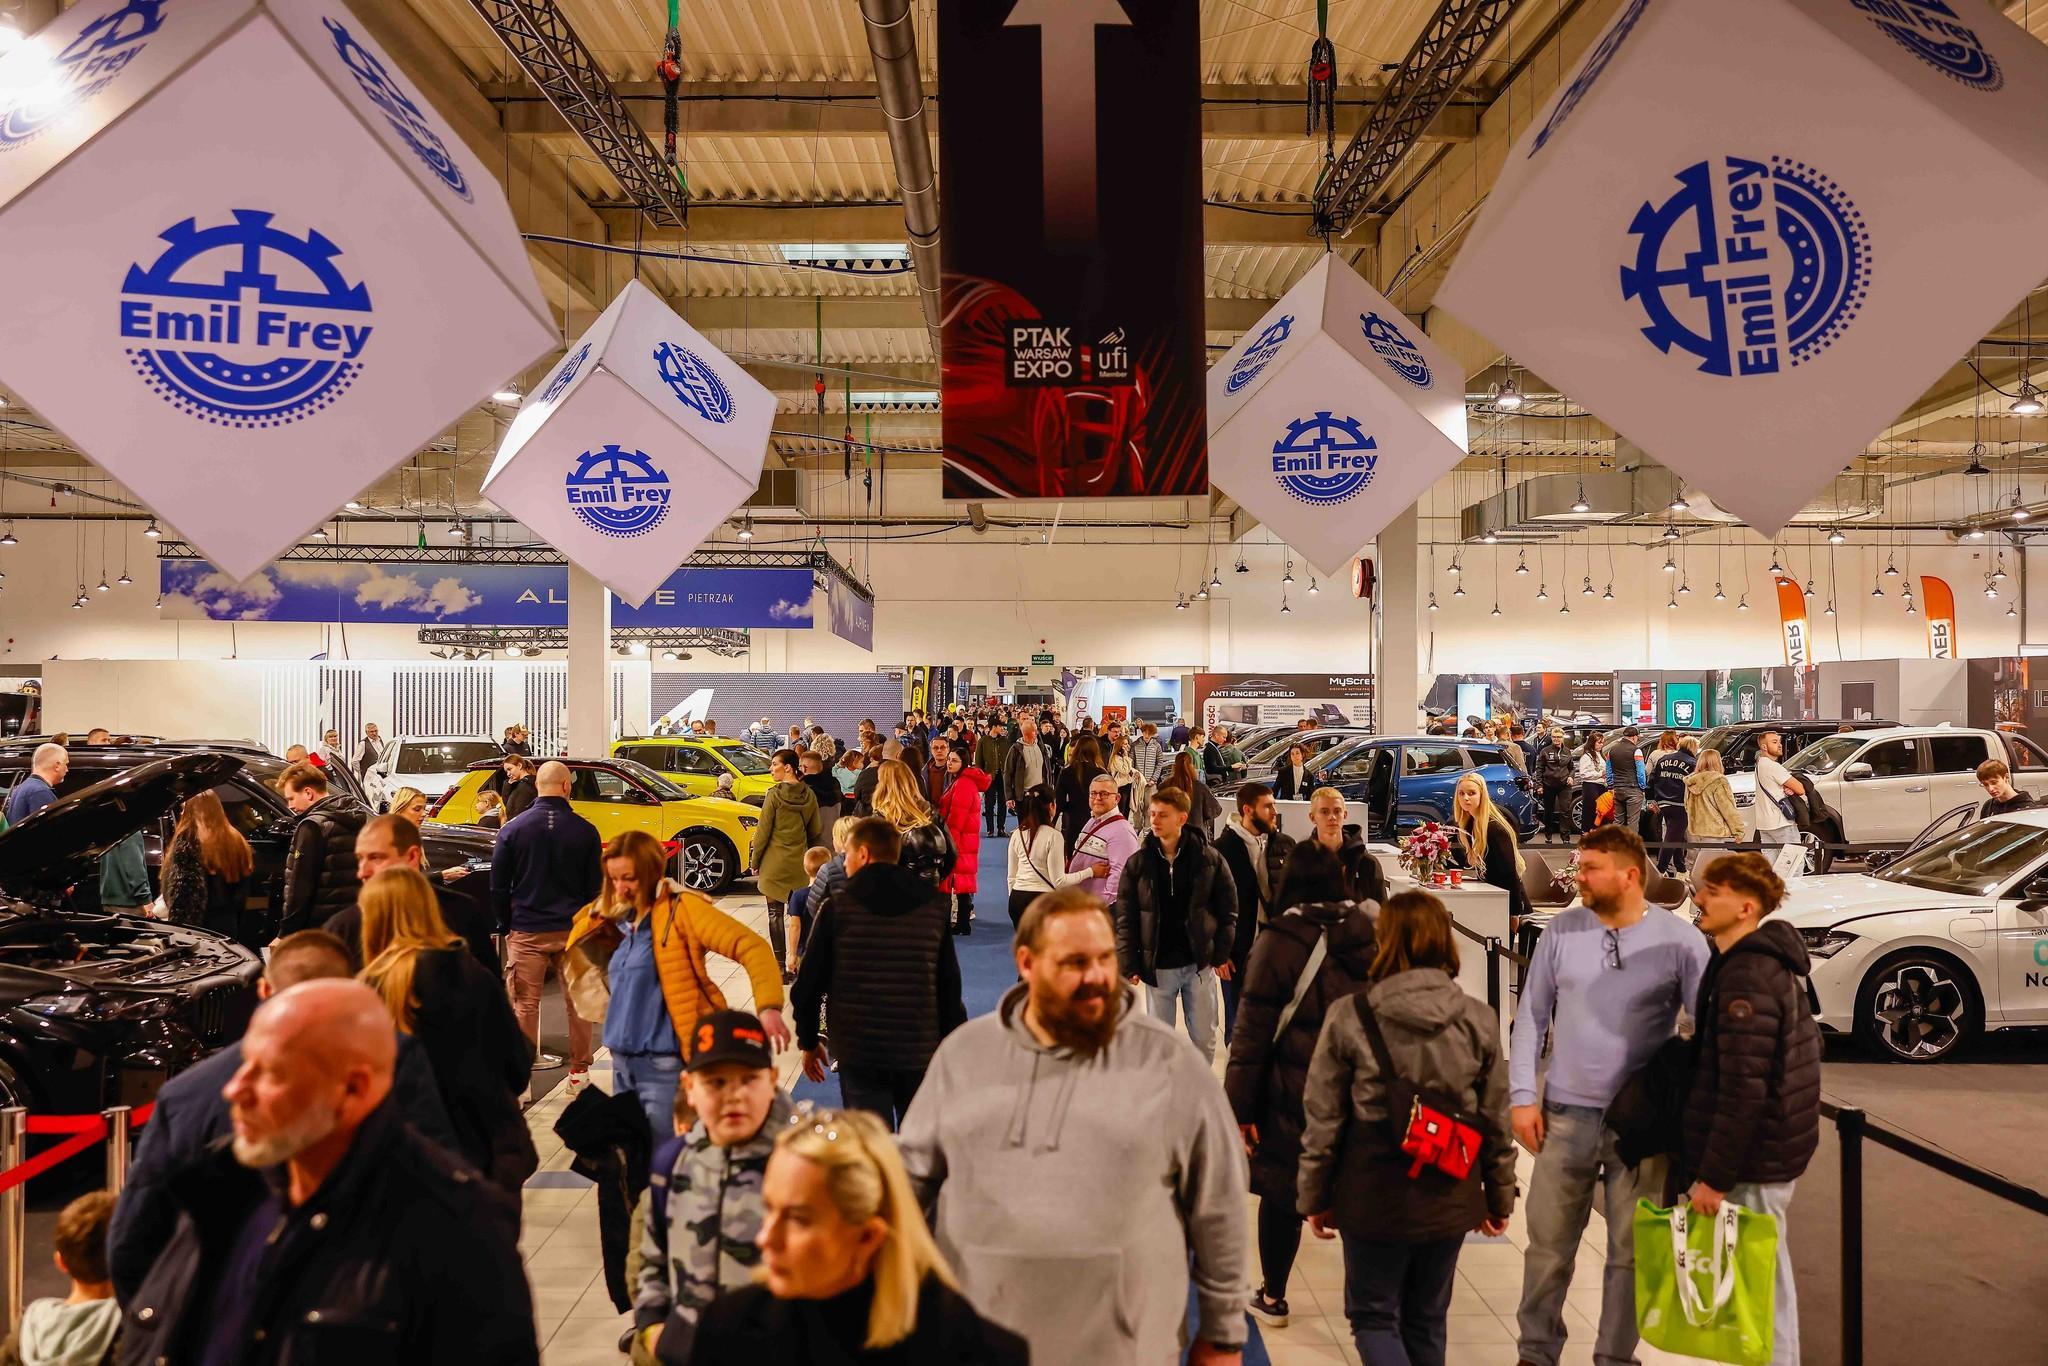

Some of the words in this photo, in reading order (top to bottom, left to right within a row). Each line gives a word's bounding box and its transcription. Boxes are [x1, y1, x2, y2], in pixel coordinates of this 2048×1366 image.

[1725, 155, 1769, 263] Frey
[120, 301, 240, 344] Emil
[257, 311, 373, 359] Frey
[1725, 274, 1779, 376] Emil
[1013, 327, 1071, 347] PTAK
[671, 342, 700, 381] Frey
[1014, 348, 1071, 360] WARSAW
[1099, 346, 1127, 369] ufi
[1232, 351, 1261, 373] Emil
[1255, 344, 1282, 363] Frey
[1368, 339, 1400, 359] Emil
[1397, 347, 1427, 367] Frey
[1014, 361, 1072, 378] EXPO
[692, 385, 726, 424] Emil
[1272, 452, 1322, 472] Emil
[1328, 453, 1378, 471] Frey
[566, 485, 617, 503] Emil
[621, 486, 671, 505] Frey
[688, 593, 734, 603] PIETRZAK
[1329, 677, 1375, 687] MyScree
[1571, 679, 1610, 687] MyScreen
[1672, 772, 1685, 780] YOR
